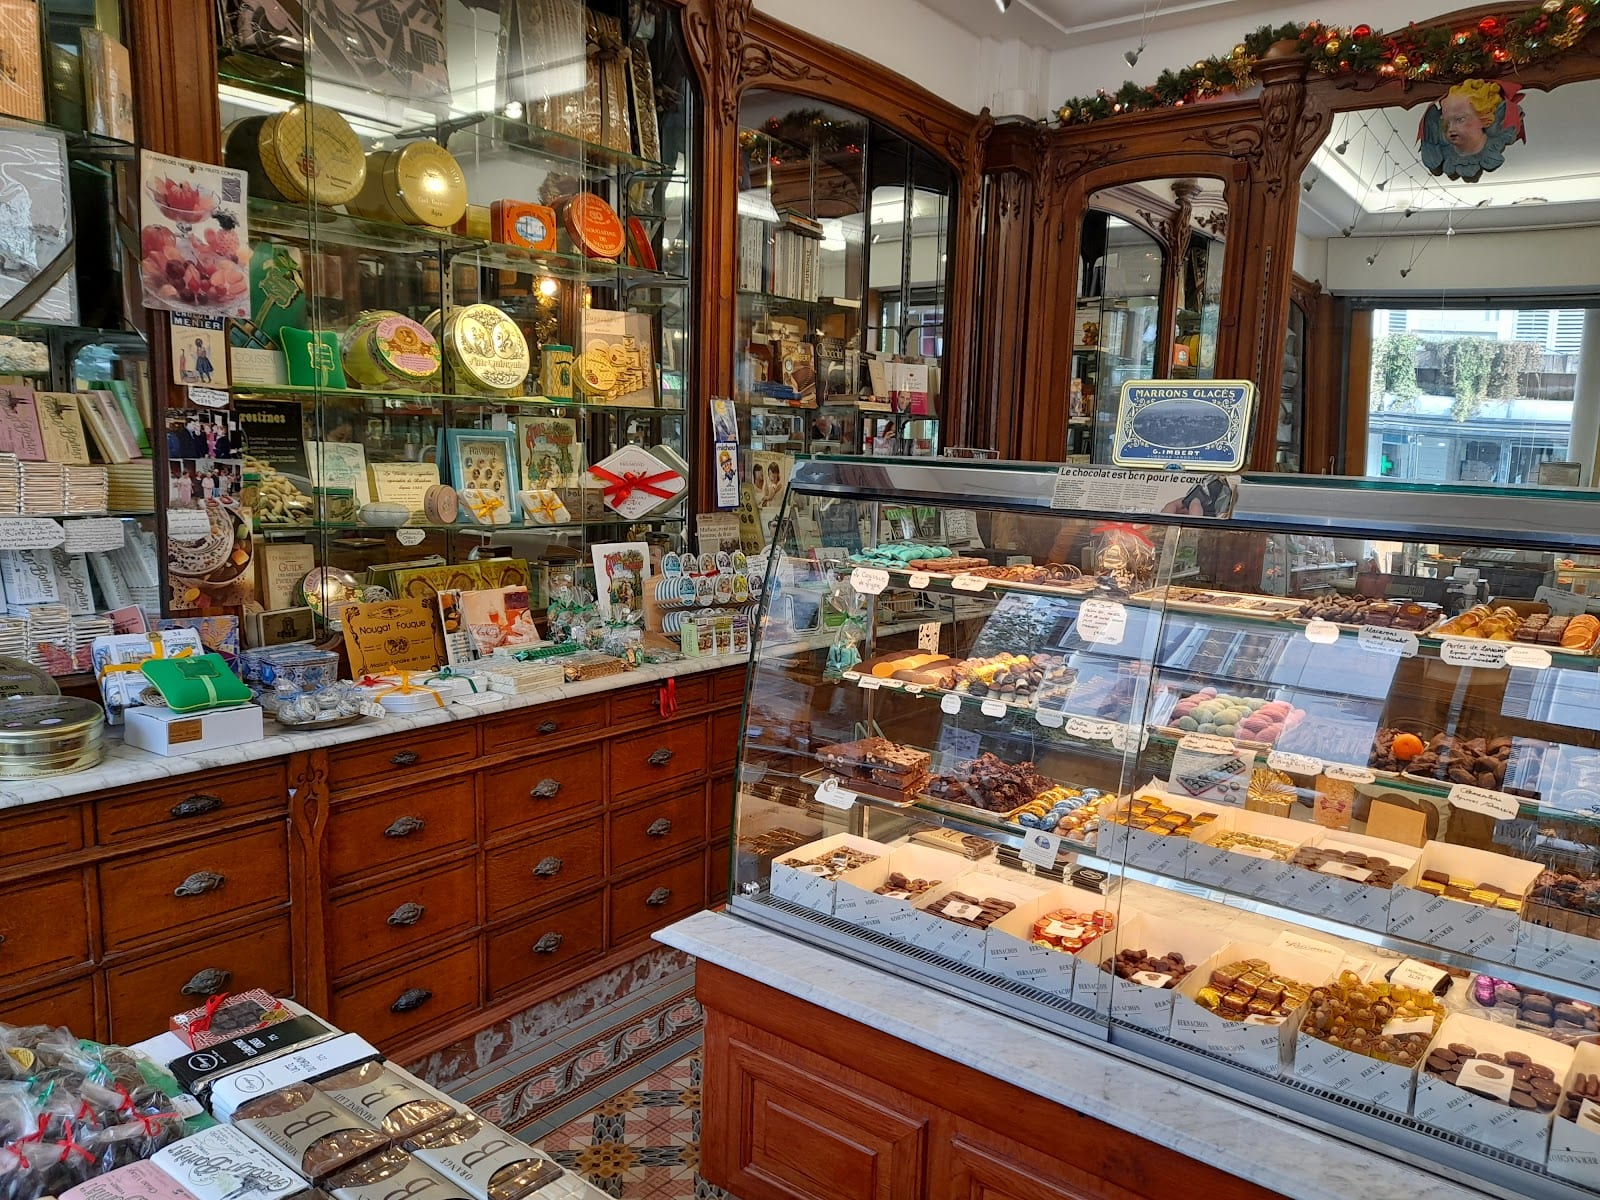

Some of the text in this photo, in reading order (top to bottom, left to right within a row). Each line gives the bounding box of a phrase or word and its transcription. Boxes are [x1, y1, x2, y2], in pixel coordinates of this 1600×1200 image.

[174, 318, 221, 330] MENIER
[1135, 388, 1236, 398] MARRONS GLACÉS
[1061, 467, 1071, 476] Le
[1072, 468, 1110, 479] chocolat
[1111, 471, 1127, 480] est
[1146, 473, 1170, 484] pour
[1170, 474, 1179, 483] le
[278, 562, 305, 572] GUIDE
[360, 619, 426, 635] Nougat Fouque
[990, 947, 1018, 956] BERNACHON
[1016, 967, 1047, 977] BERNACHON
[1177, 1019, 1209, 1028] BERNACHON
[283, 1110, 338, 1139] B
[462, 1140, 514, 1169] B
[440, 1158, 474, 1181] ORANGE
